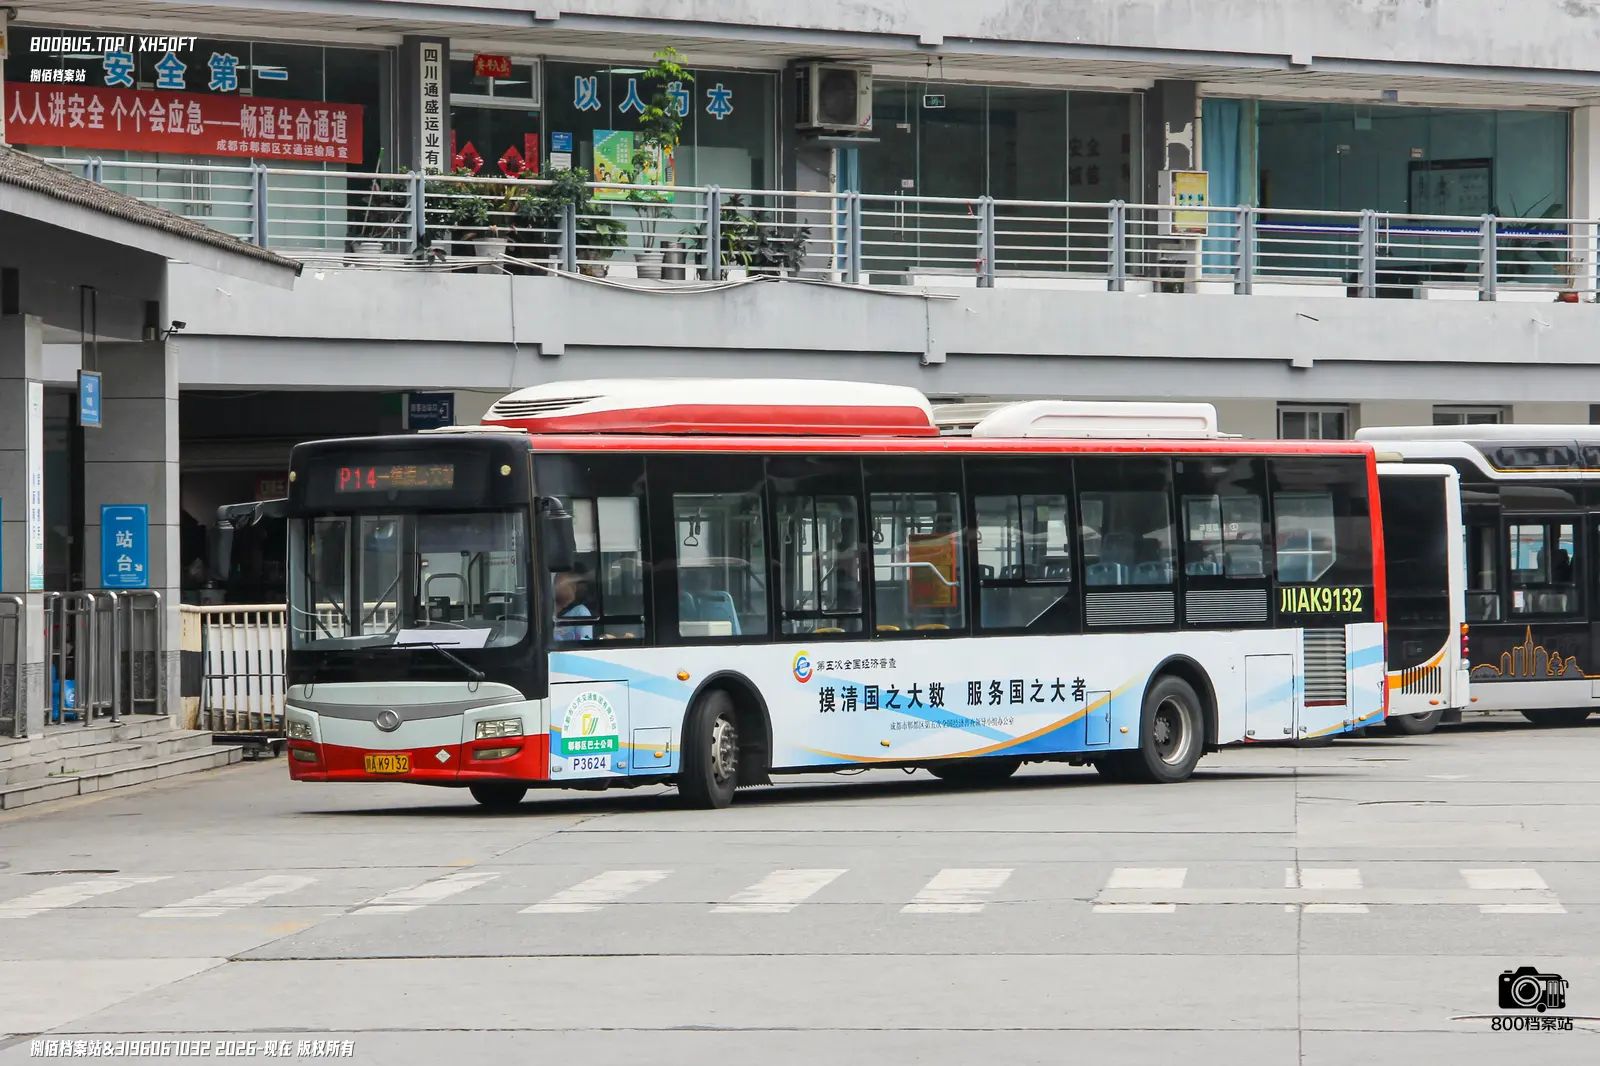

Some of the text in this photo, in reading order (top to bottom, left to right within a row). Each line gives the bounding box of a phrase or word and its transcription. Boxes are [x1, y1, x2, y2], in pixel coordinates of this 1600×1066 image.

[103, 48, 289, 92] 安全第一
[9, 90, 105, 130] 人人讲安全
[573, 75, 734, 120] 以人为本
[339, 467, 377, 491] P14
[115, 516, 133, 572] 一站台
[1280, 587, 1363, 613] 川AK9132
[816, 657, 898, 672] 第五次全国经济普查
[818, 676, 1087, 713] 摸清国之大数 服务国之大者
[573, 756, 607, 771] P3624
